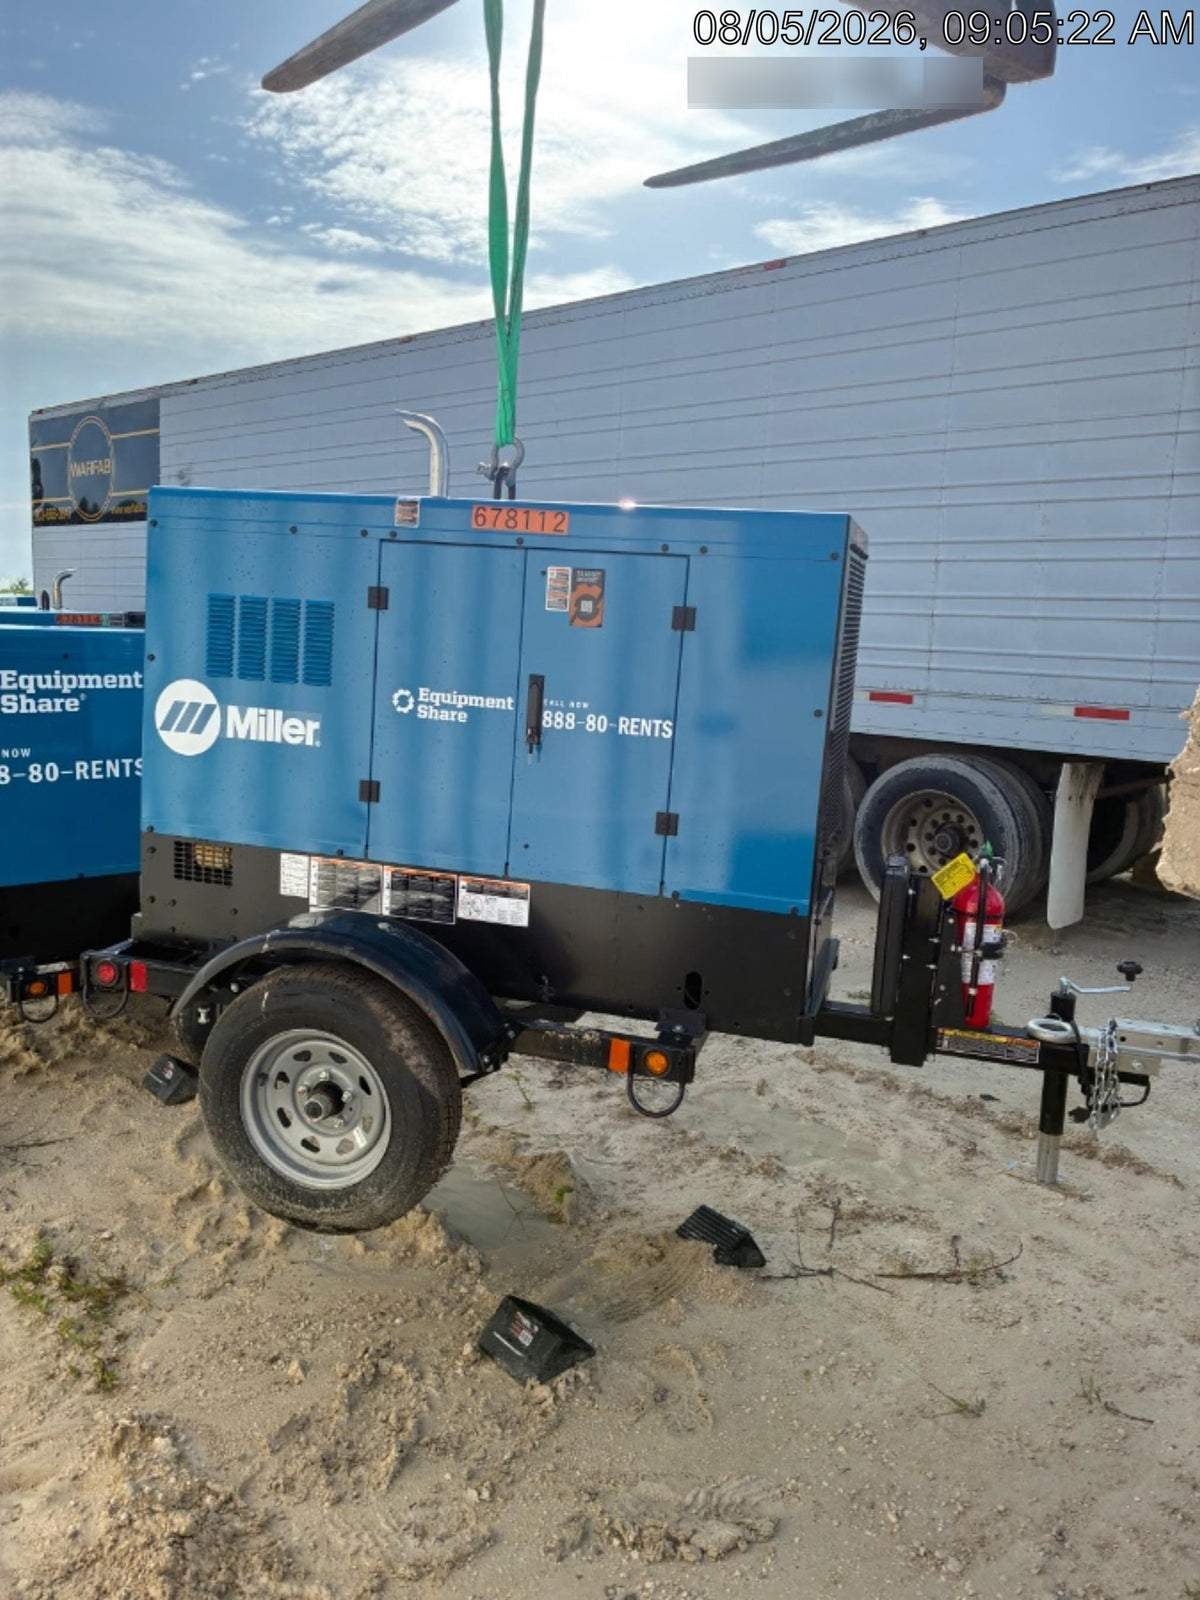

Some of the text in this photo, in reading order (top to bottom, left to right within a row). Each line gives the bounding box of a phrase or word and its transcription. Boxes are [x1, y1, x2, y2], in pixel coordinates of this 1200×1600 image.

[70, 458, 111, 478] WARFAB
[474, 506, 566, 533] 678112
[0, 670, 143, 694] Equipment
[418, 687, 514, 711] Equipment
[569, 701, 590, 709] NOW
[226, 704, 321, 747] Miller
[417, 705, 468, 723] Share
[542, 711, 673, 739] 888-80-RENTS
[1, 748, 31, 758] NOW
